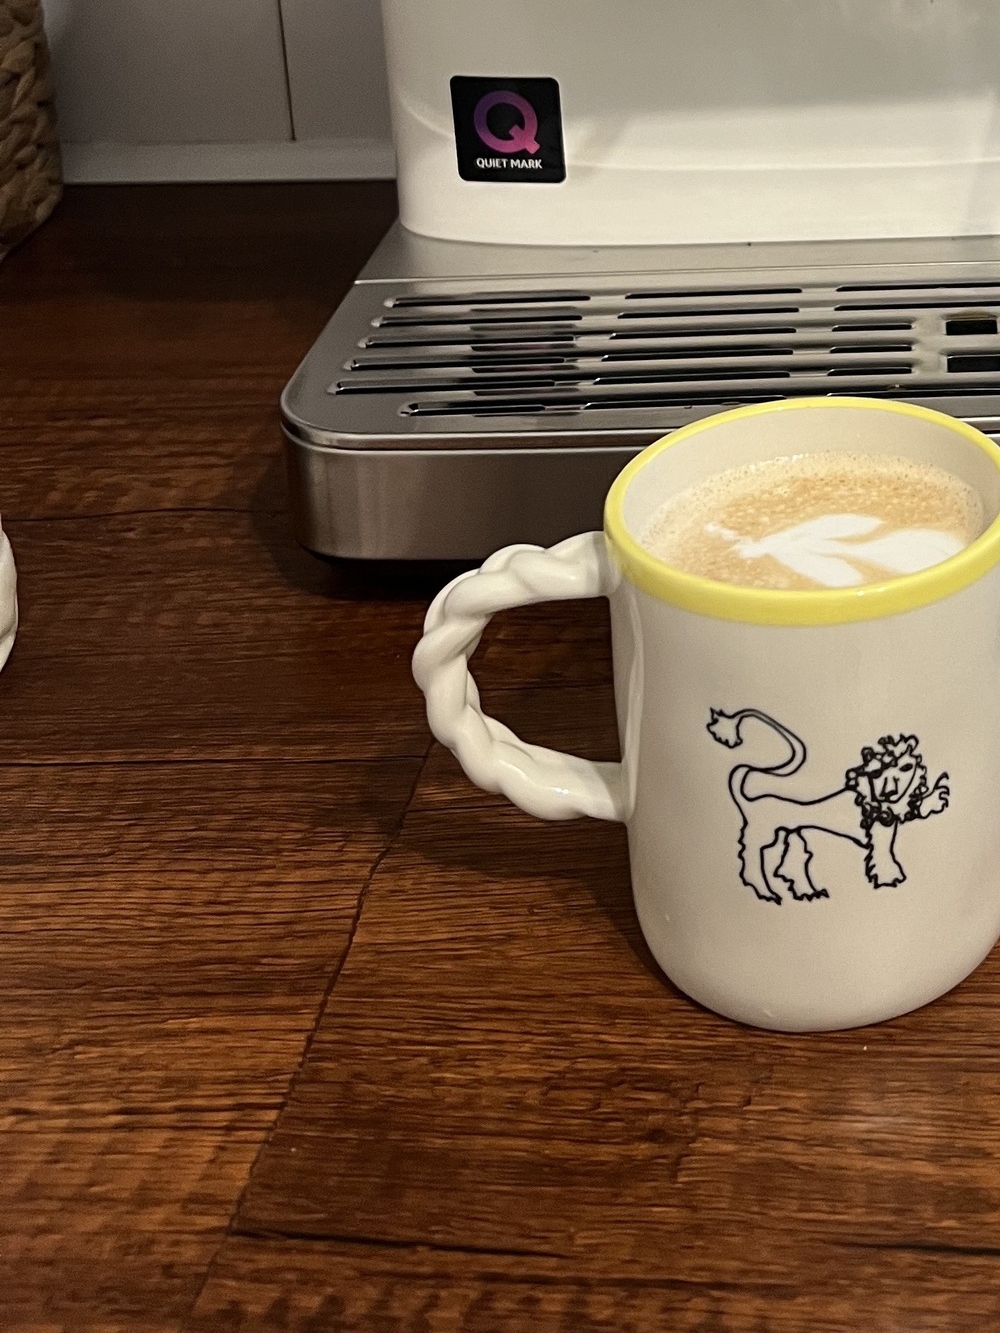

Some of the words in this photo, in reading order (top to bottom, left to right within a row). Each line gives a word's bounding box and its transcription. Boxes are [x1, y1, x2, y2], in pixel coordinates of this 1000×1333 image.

[473, 90, 540, 155] Q
[476, 157, 508, 169] QUIET
[510, 158, 543, 170] MARK
